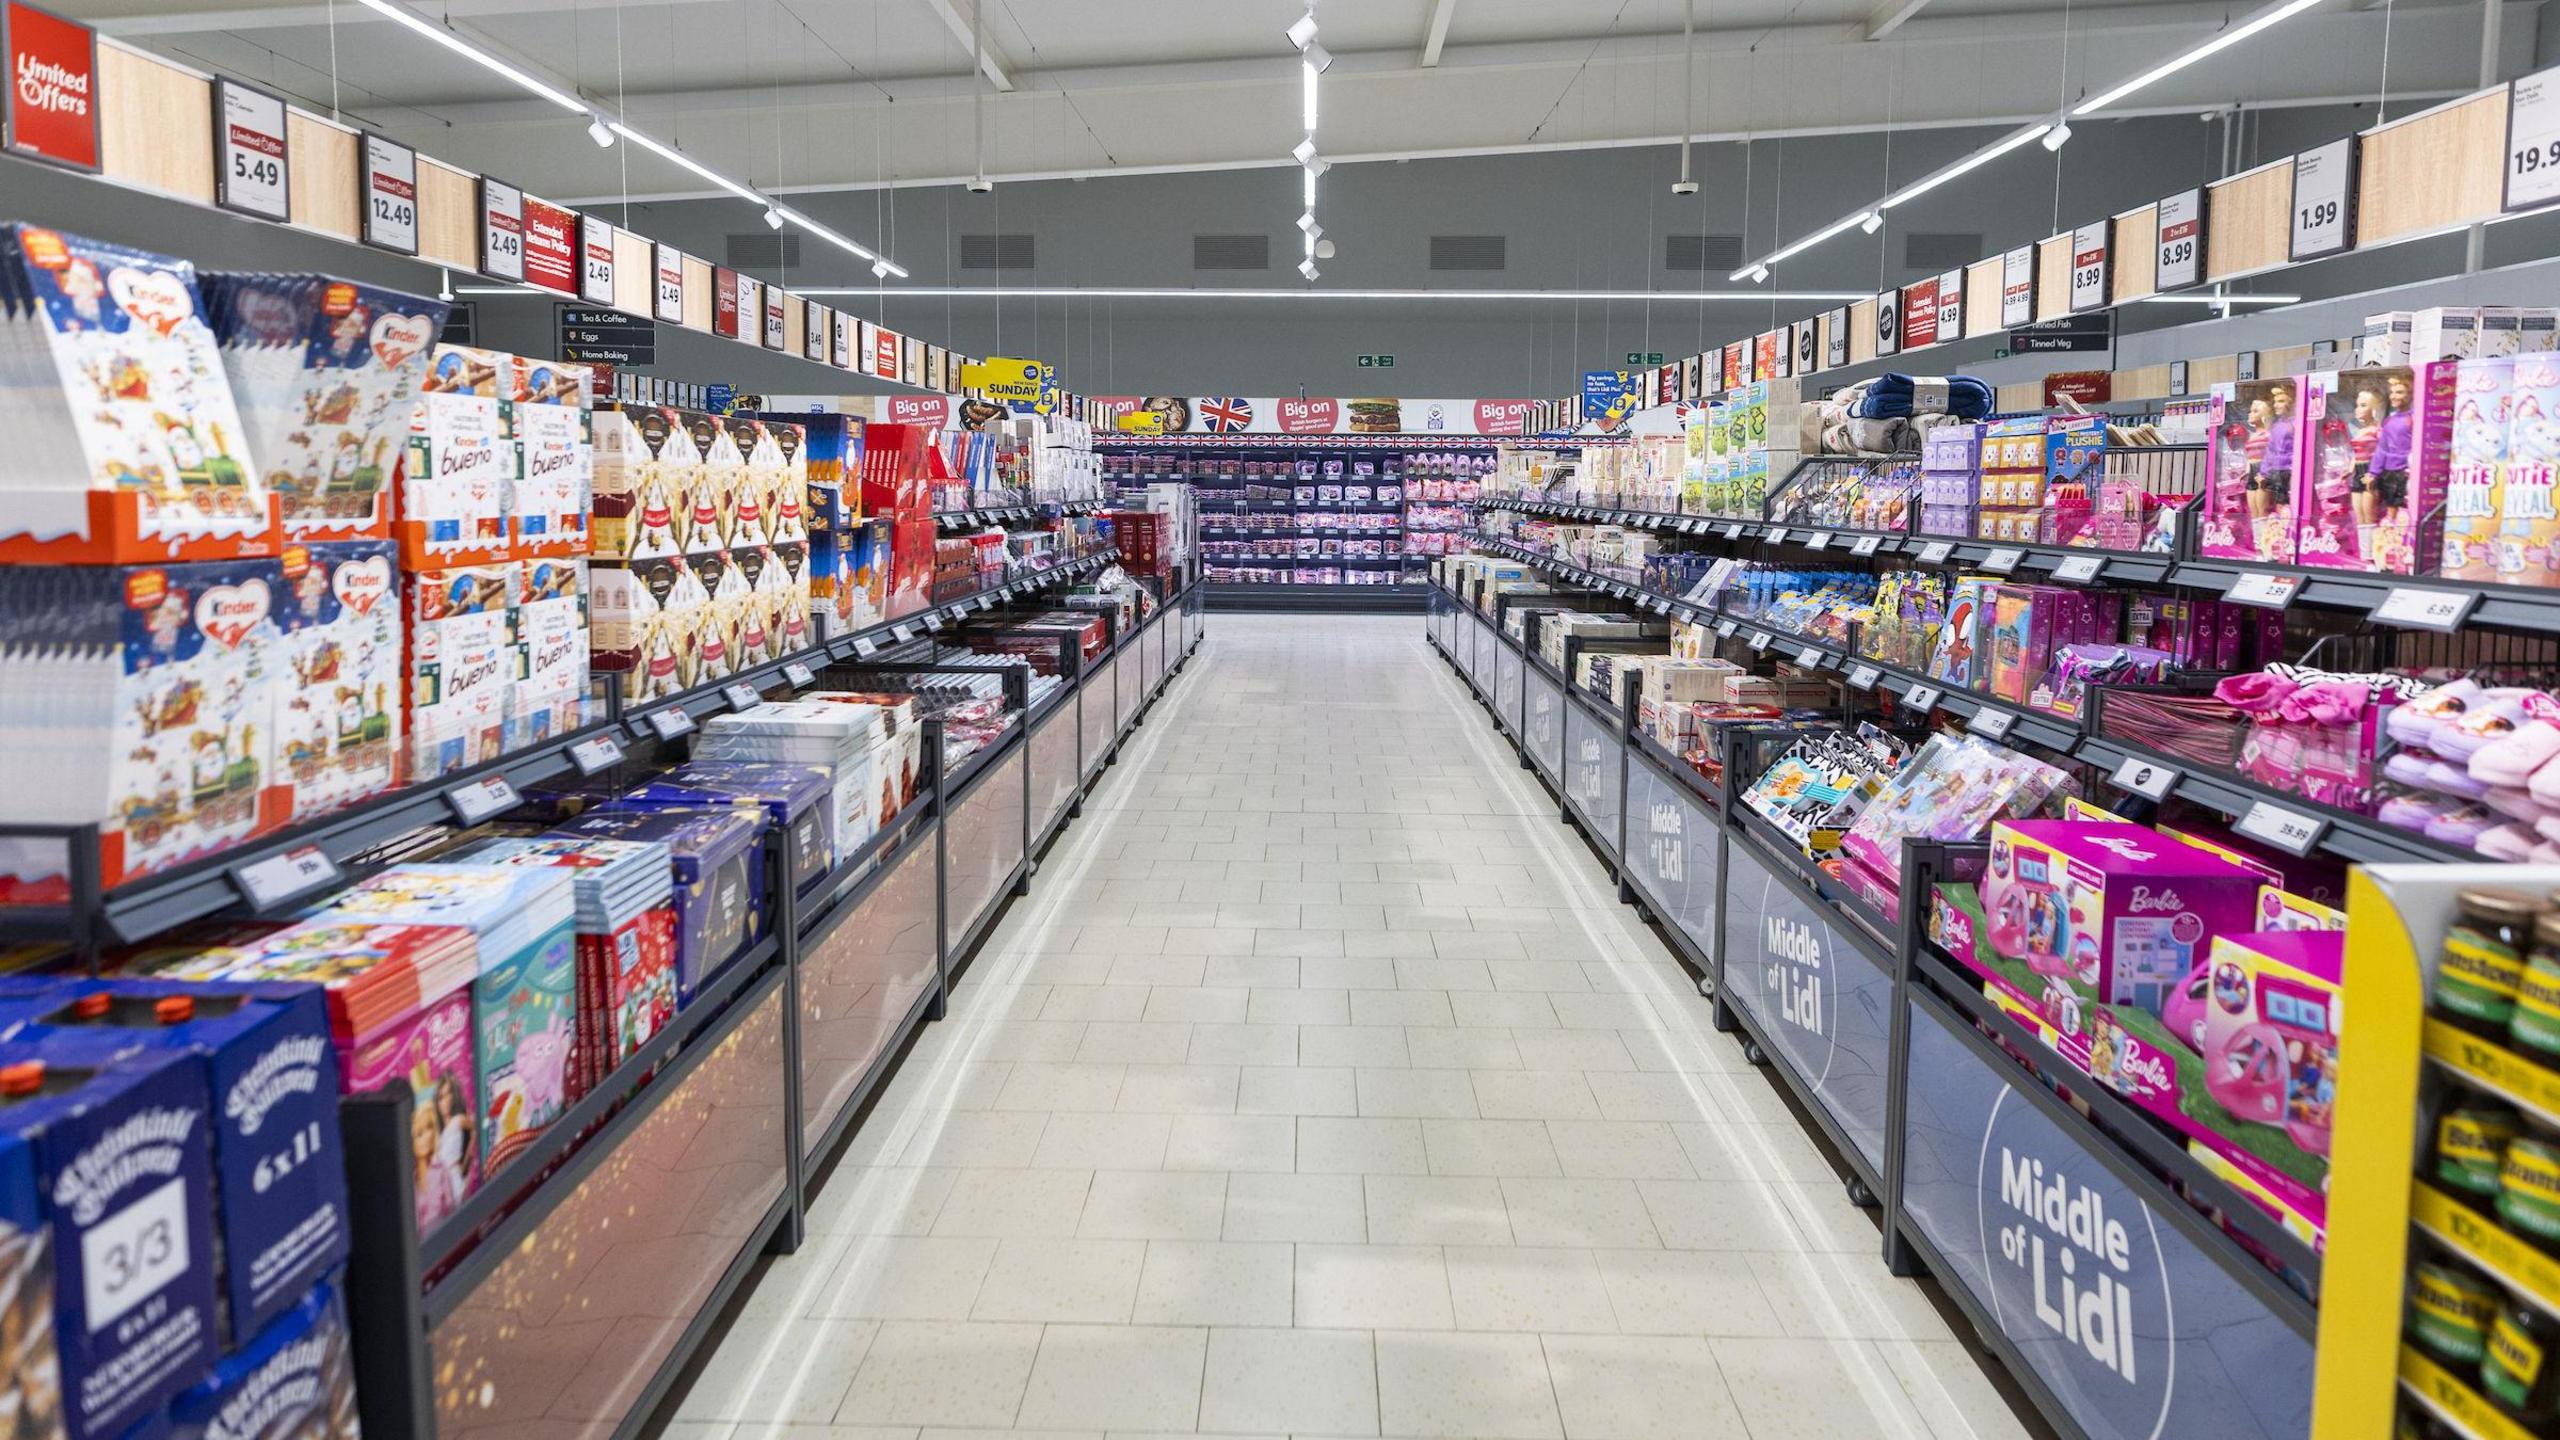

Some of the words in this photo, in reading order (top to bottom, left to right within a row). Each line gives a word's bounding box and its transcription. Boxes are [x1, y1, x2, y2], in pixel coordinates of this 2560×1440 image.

[18, 52, 87, 95] Limited
[19, 76, 87, 117] Offers
[232, 129, 260, 147] Limited
[261, 136, 282, 154] Offer
[235, 152, 278, 187] 5.49
[373, 198, 412, 226] 12.49
[2301, 200, 2337, 230] 1.99
[491, 231, 518, 256] 2.49
[2162, 241, 2193, 266] 8.99
[589, 261, 609, 283] 2.49
[2076, 267, 2100, 289] 8.99
[661, 285, 679, 303] 2.49
[581, 313, 594, 323] Tea
[595, 314, 602, 323] &
[602, 314, 627, 324] Coffee
[768, 318, 782, 335] 2.49
[1940, 307, 1958, 324] 4.99
[2057, 319, 2072, 329] Fish
[581, 331, 599, 342] Eggs
[2030, 338, 2055, 349] Tinned
[2055, 338, 2072, 350] Veg
[581, 350, 603, 359] Home
[604, 350, 628, 362] Baking
[989, 383, 1038, 397] SUNDAY
[896, 400, 919, 417] Big
[921, 399, 941, 411] on
[1116, 401, 1135, 412] on
[1284, 401, 1309, 419] Big
[1311, 400, 1330, 414] on
[1481, 403, 1505, 420] Big
[1507, 401, 1526, 415] on
[1134, 425, 1160, 433] SUNDAY
[2066, 435, 2104, 448] PLUSHIE
[441, 447, 492, 477] bueno
[532, 450, 575, 478] bueno
[2202, 523, 2237, 549] Barbie
[2300, 525, 2341, 555] Barbie
[2131, 612, 2150, 622] EXTRA
[536, 641, 574, 674] bueno
[450, 660, 498, 697] bueno
[2033, 695, 2050, 705] EXTRA
[1651, 804, 1682, 835] Middle
[1658, 837, 1684, 883] Lidl
[2129, 885, 2185, 914] Barbie
[1944, 907, 1971, 946] Barbie
[1767, 916, 1820, 970] Middle
[1767, 967, 1780, 991] of
[1780, 967, 1823, 1036] Lidl
[2122, 1038, 2173, 1093] Barbie
[2001, 1146, 2131, 1273] Middle
[103, 1216, 173, 1296] 3/3
[2001, 1224, 2027, 1269] of
[2032, 1234, 2137, 1386] Lidl
